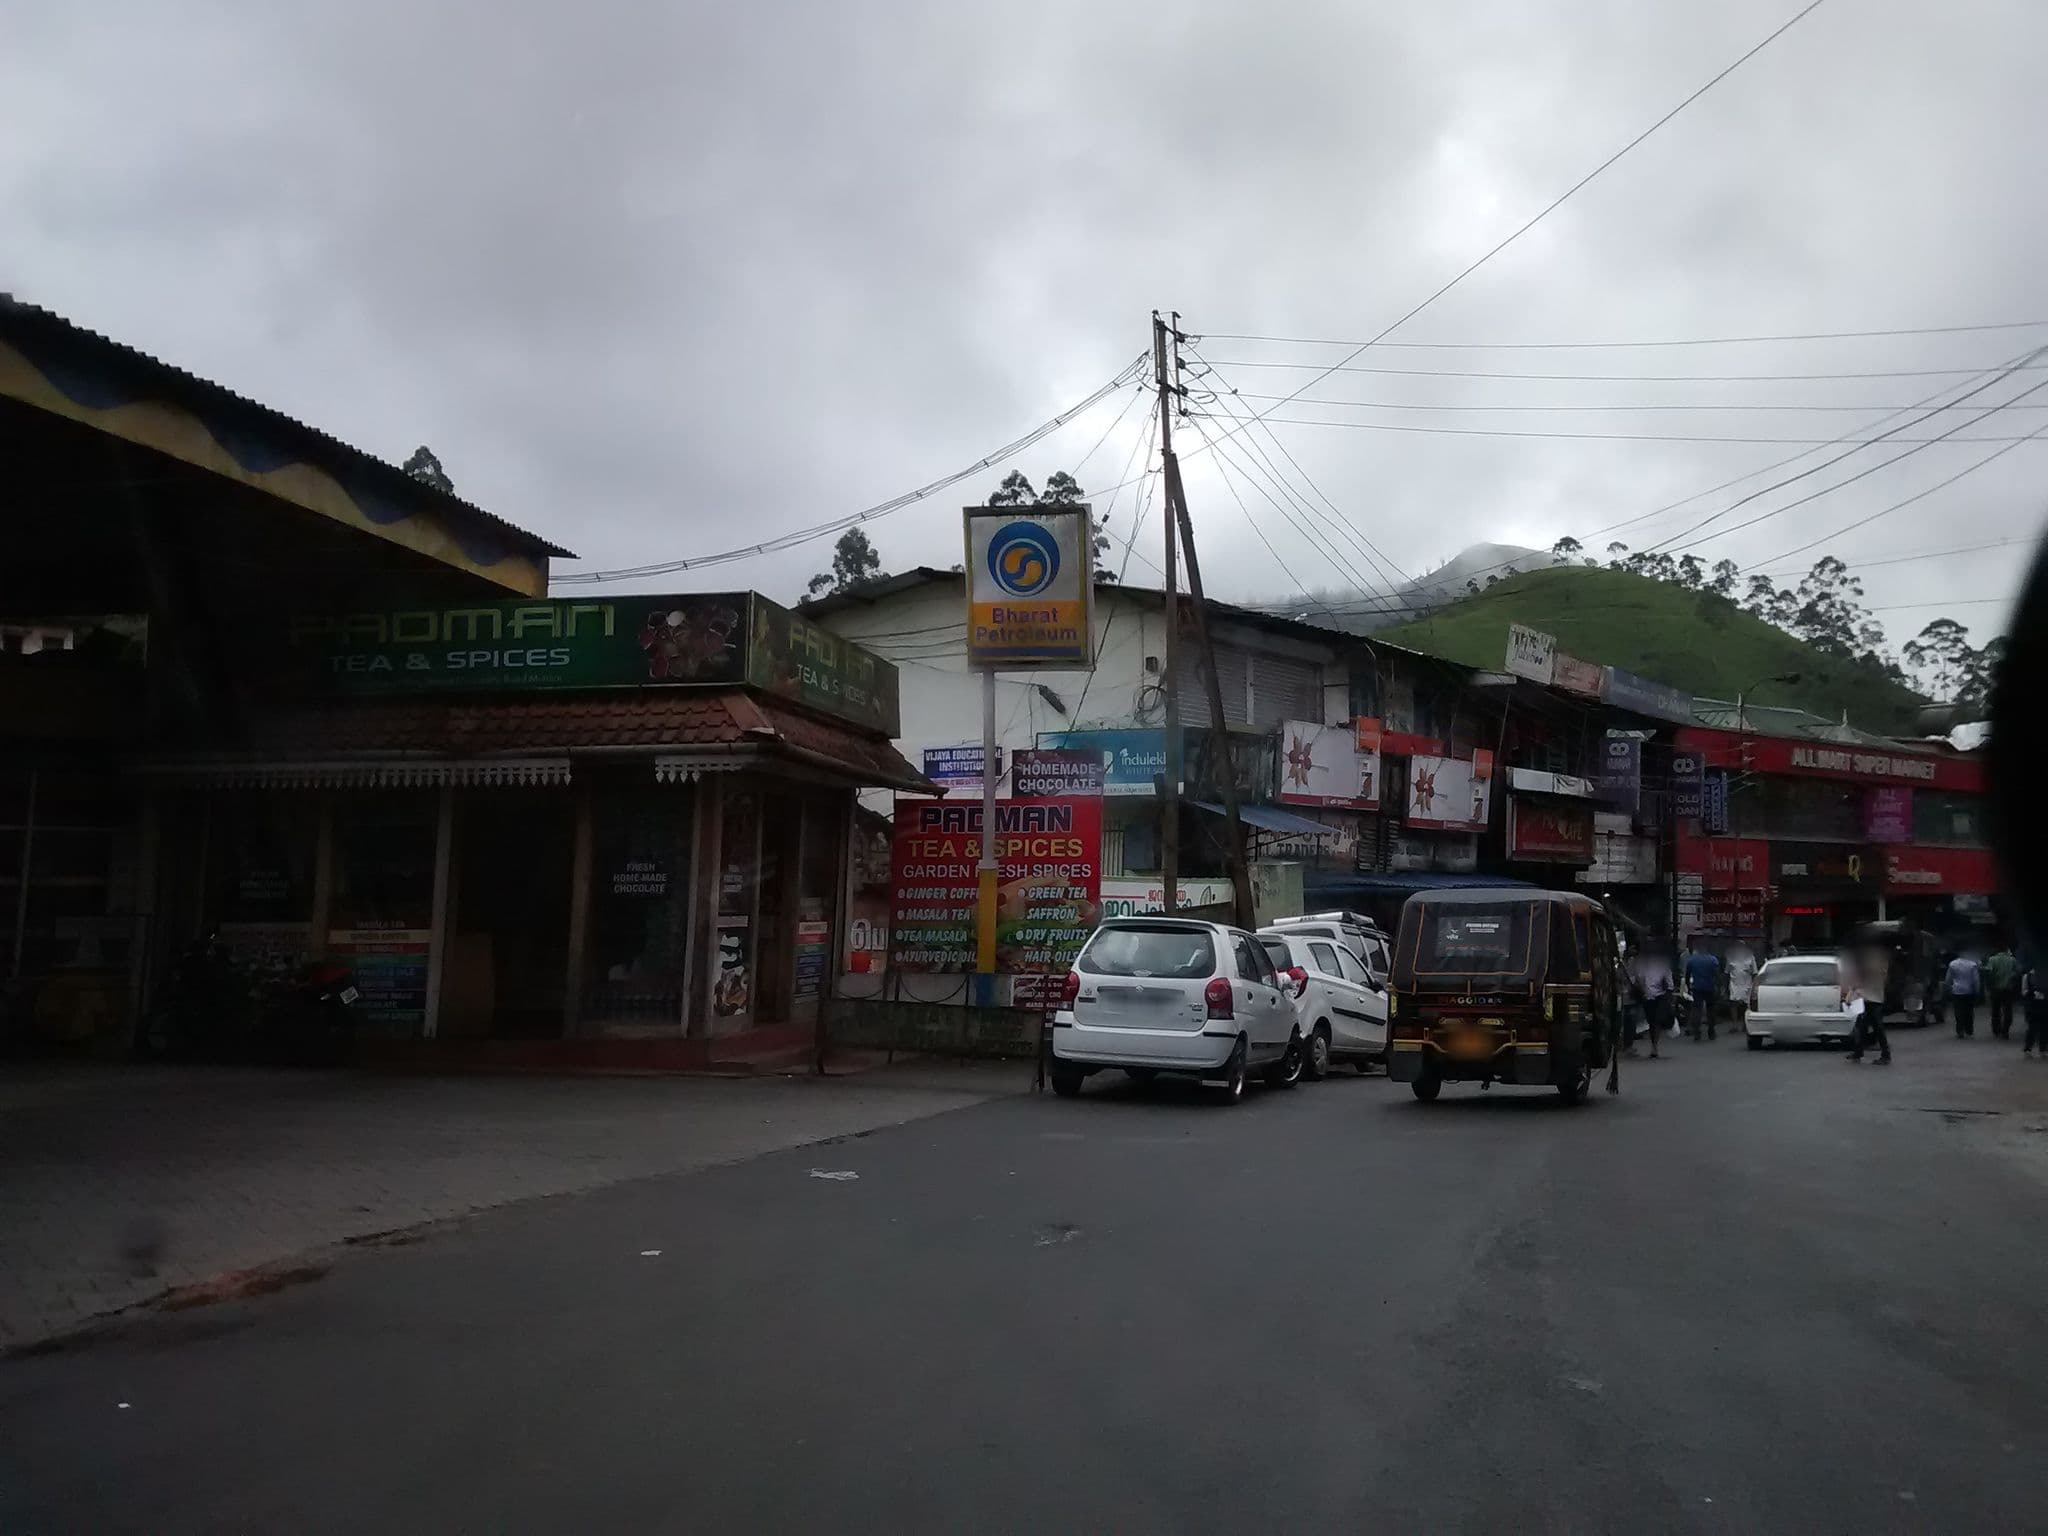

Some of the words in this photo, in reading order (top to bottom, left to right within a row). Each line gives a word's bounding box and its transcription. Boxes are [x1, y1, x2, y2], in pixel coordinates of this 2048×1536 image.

[992, 607, 1058, 624] Bharat
[975, 625, 1077, 641] Petroleum
[329, 654, 393, 673] TEA
[405, 653, 432, 671] &
[446, 648, 571, 670] SPICES
[797, 664, 818, 687] TEA
[821, 676, 829, 692] &
[926, 751, 952, 762] VIJAYA
[1022, 763, 1096, 776] HOMEMADE
[1018, 777, 1096, 791] CHOCOLATE
[918, 804, 1073, 834] PADMAN
[908, 839, 957, 858] TEA
[964, 839, 981, 858] &
[994, 838, 1083, 858] SPICES
[902, 864, 970, 878] GARDEN
[1032, 864, 1092, 878] SPICES
[906, 887, 947, 900] GINGER
[949, 887, 979, 900] COFF
[1028, 886, 1065, 899] GREEN
[1067, 886, 1088, 899] TEA
[905, 908, 949, 921] MASALA
[951, 908, 970, 921] TEA
[1026, 907, 1076, 920] SAFFRON
[903, 930, 922, 942] TEA
[925, 930, 968, 942] MASALA
[1025, 929, 1047, 941] DRY
[1049, 929, 1089, 941] FRUITS
[902, 951, 957, 963] AYURVEDIC
[1024, 951, 1052, 963] HAIR
